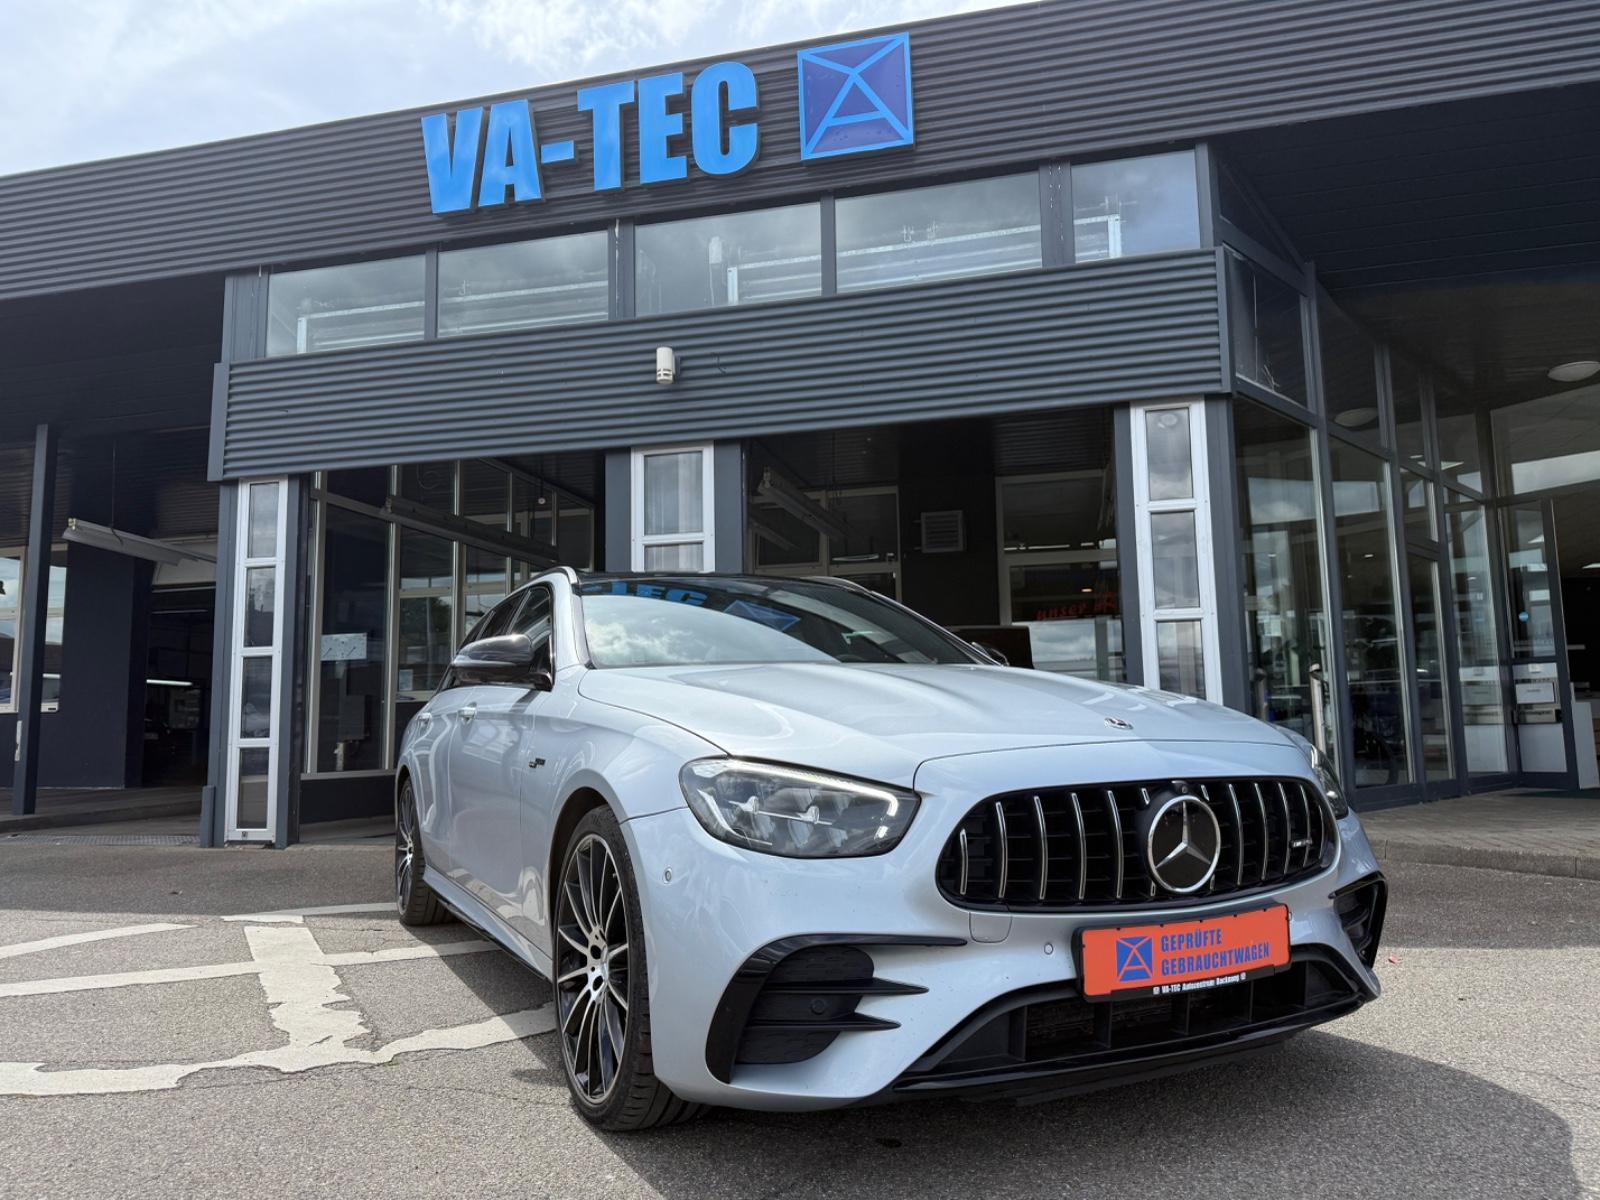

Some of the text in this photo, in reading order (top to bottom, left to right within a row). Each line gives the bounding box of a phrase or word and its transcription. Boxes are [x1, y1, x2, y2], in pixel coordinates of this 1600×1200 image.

[421, 61, 758, 214] VA-TEC
[1161, 928, 1222, 952] GEPRÜFTE
[1161, 943, 1269, 976] GEBRAUCHTWAGEN
[1161, 983, 1181, 994] VA-TEC
